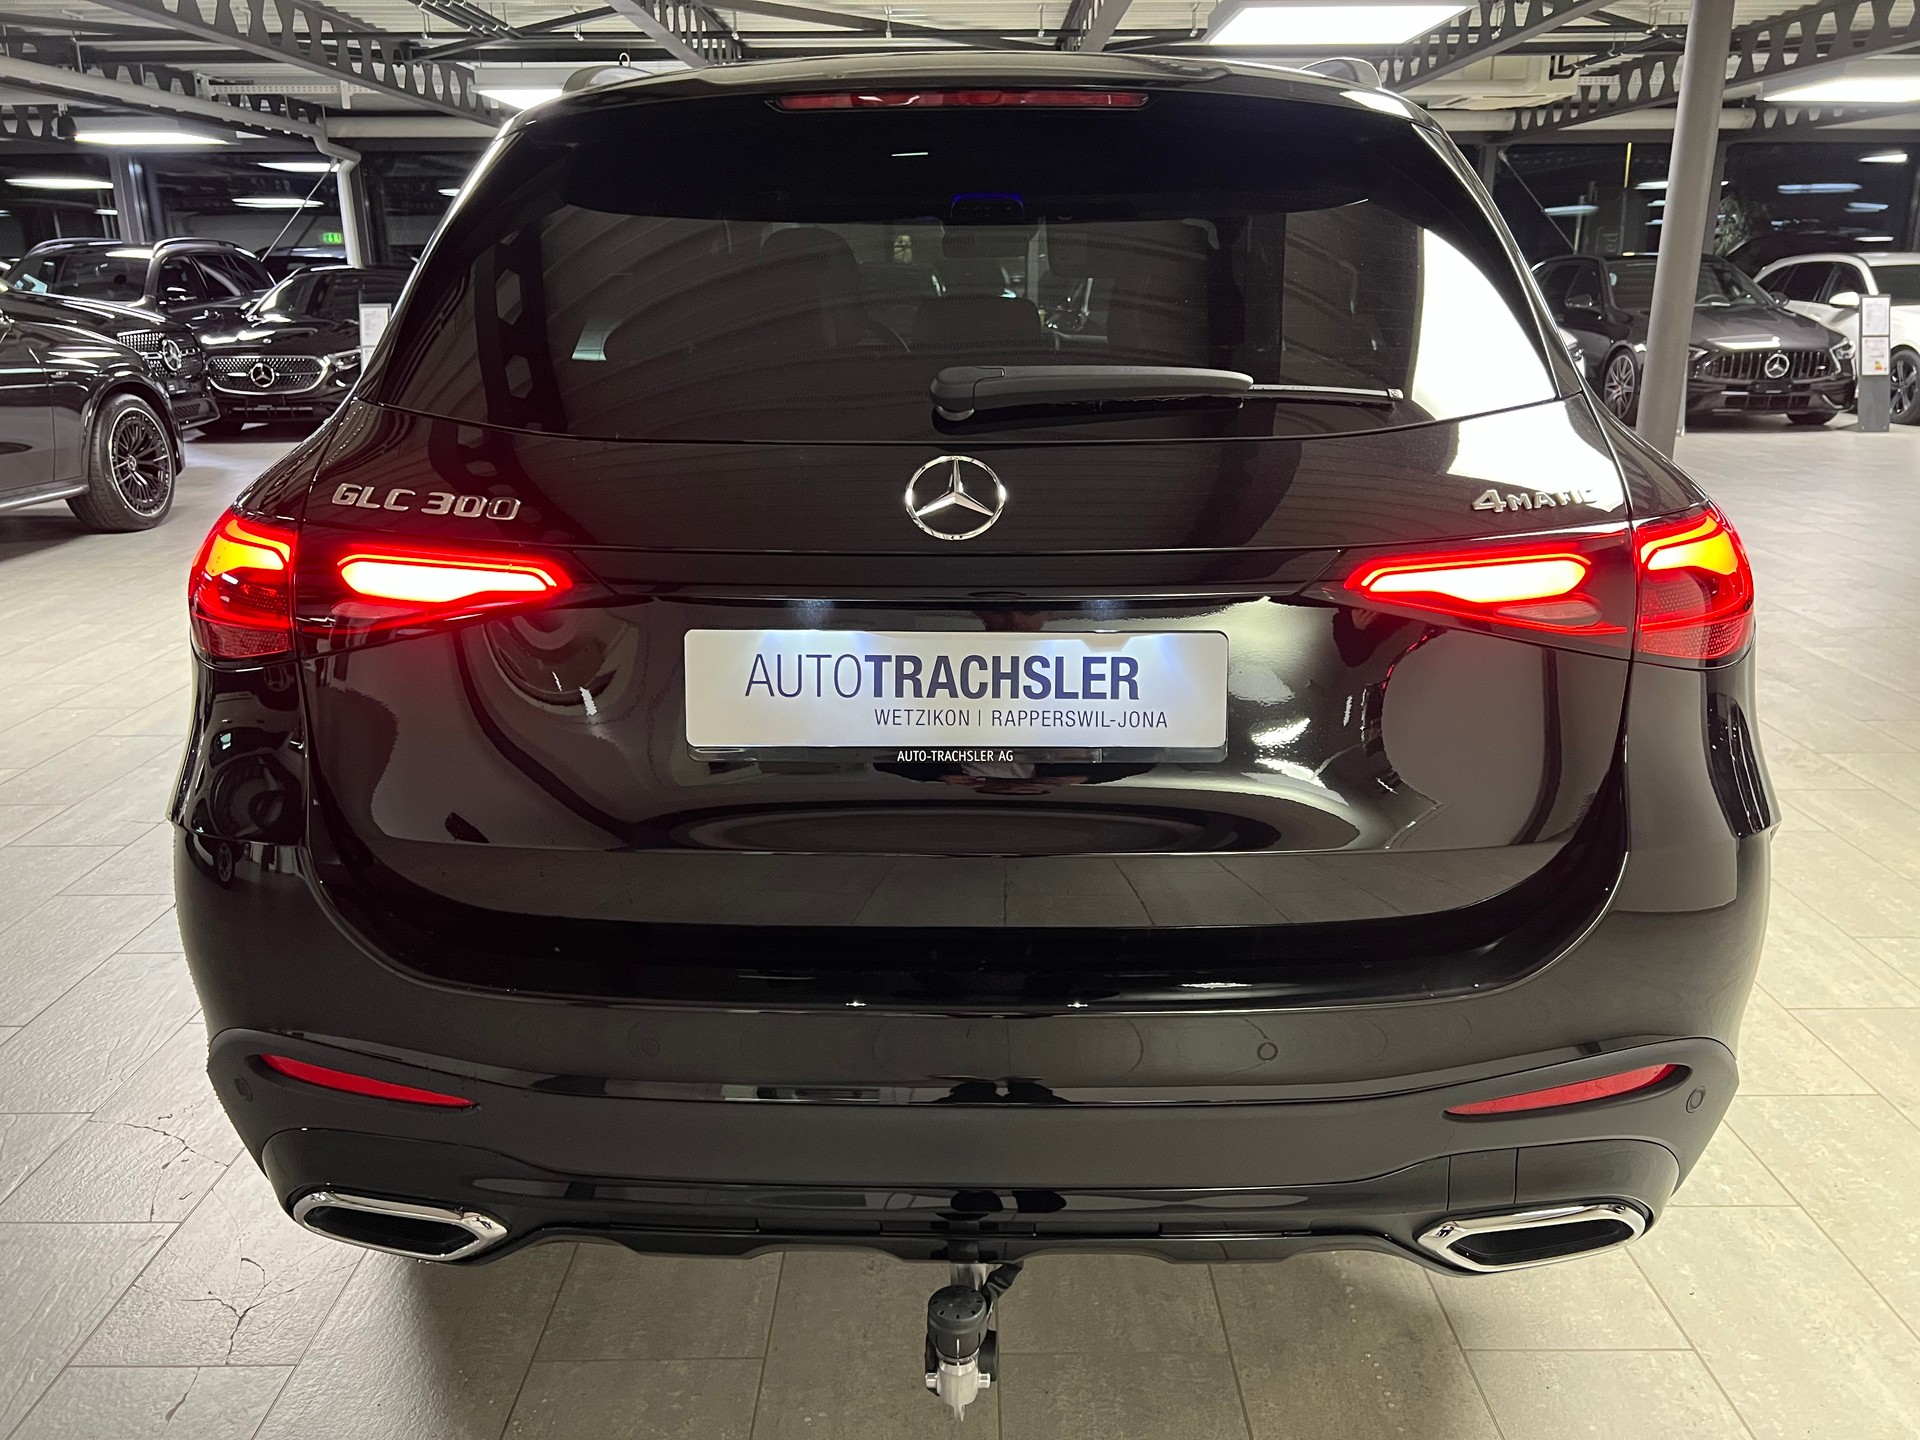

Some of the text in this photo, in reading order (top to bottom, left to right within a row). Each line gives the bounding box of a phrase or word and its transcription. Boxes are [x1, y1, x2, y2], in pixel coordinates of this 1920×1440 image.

[332, 482, 521, 521] GLC 300
[745, 653, 1140, 700] AUTOTRACHSLER
[874, 708, 970, 727] WETZIKON
[991, 709, 1168, 729] RAPPERSWIL-JONA
[896, 749, 1014, 763] AUTO-TRACHSLER AG
